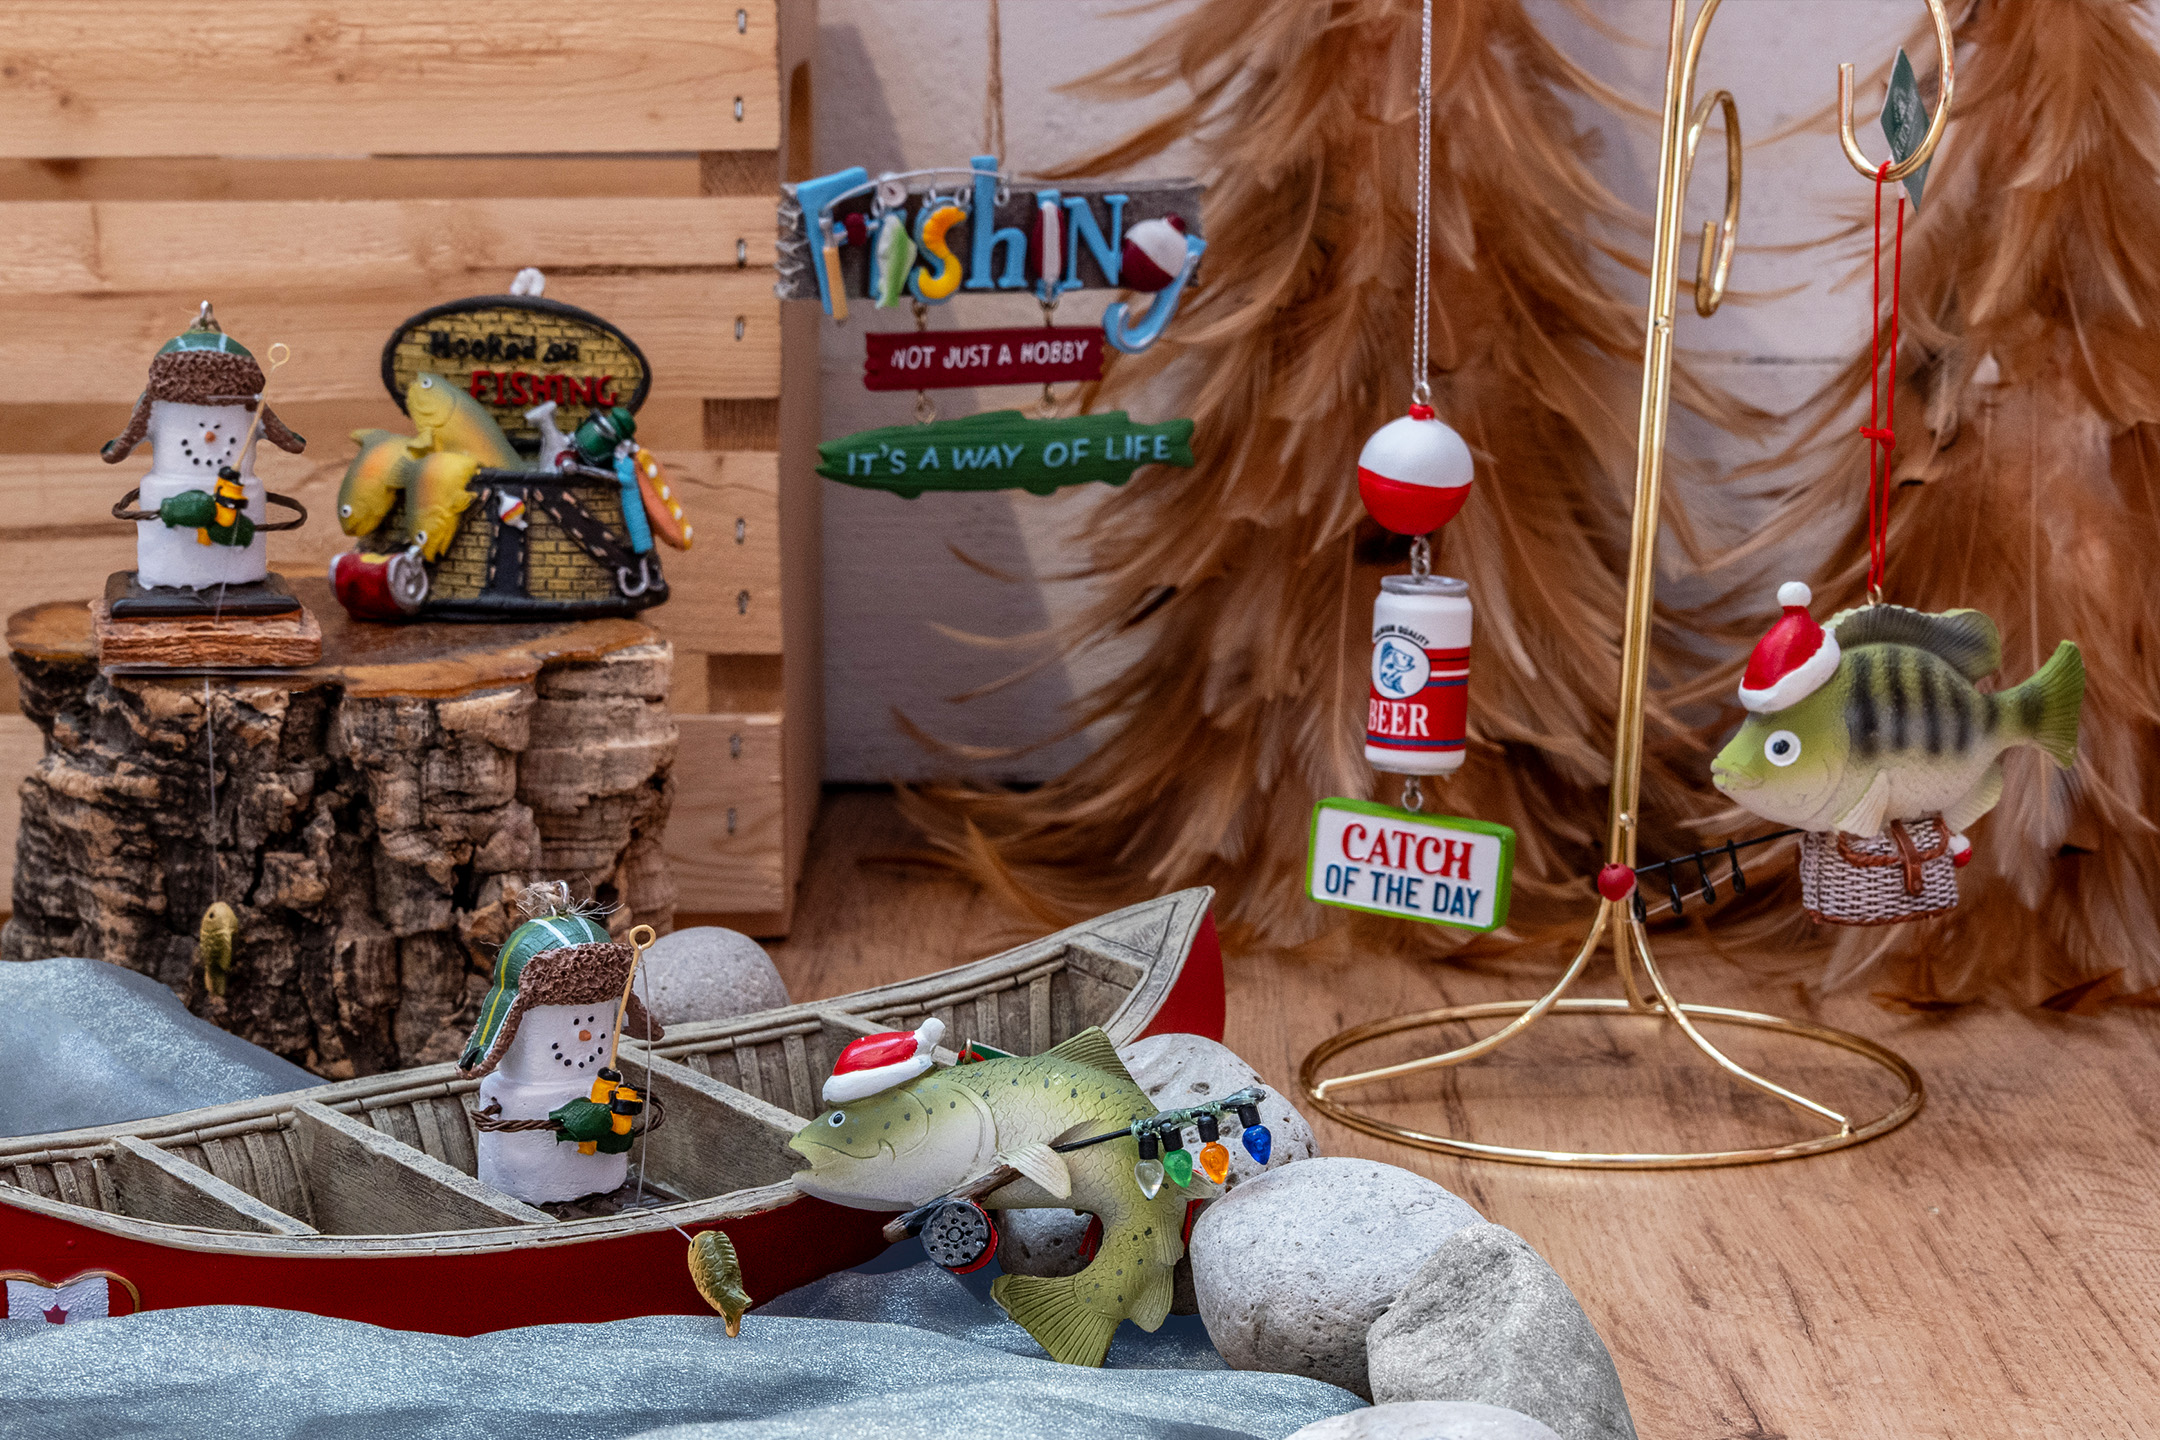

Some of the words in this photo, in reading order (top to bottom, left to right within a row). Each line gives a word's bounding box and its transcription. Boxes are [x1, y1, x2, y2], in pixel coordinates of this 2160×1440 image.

[890, 345, 936, 370] NOT
[942, 343, 993, 369] JUST
[997, 343, 1013, 366] A
[1020, 339, 1089, 365] HOBBY
[470, 371, 617, 406] FISHING
[847, 443, 907, 475] IT'S
[918, 447, 940, 470] A
[952, 444, 1025, 470] WAY
[1042, 438, 1090, 467] OF
[1104, 435, 1172, 462] LIFE
[1367, 697, 1430, 737] BEER
[1341, 823, 1474, 881] CATCH
[1325, 863, 1360, 896] OF
[1370, 870, 1423, 909] THE
[1432, 882, 1481, 918] DAY
